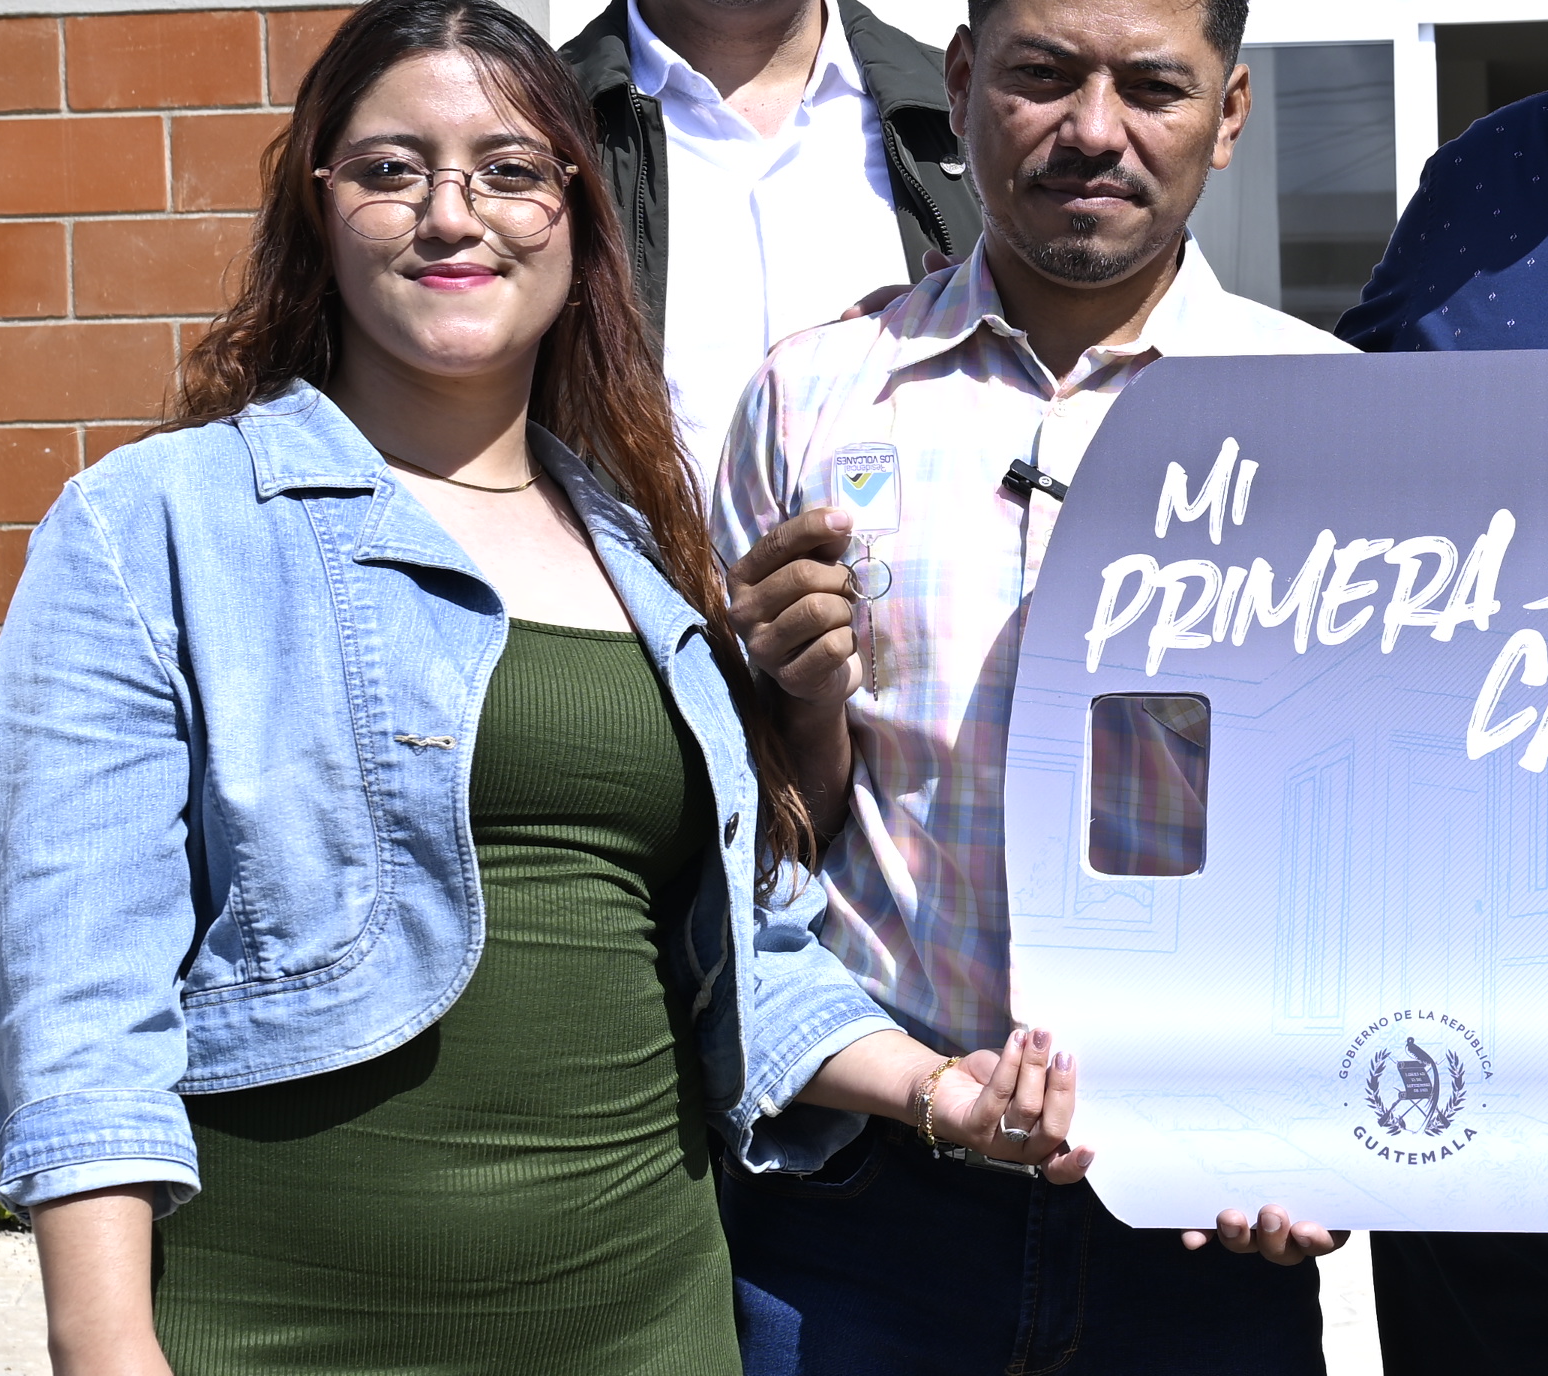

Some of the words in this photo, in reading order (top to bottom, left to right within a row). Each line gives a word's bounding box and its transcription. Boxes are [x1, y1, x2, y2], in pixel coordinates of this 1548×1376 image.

[836, 455, 879, 465] VOLCANES
[880, 454, 895, 463] LOS
[1155, 436, 1259, 545] MI
[1084, 508, 1517, 676] PRIMERA
[1339, 1017, 1389, 1080] GOBIERNO
[1394, 1010, 1412, 1022] DE
[1418, 1010, 1435, 1020] LA
[1440, 1014, 1494, 1080] REPÚBLICA
[1353, 1126, 1478, 1165] GUATEMALA
